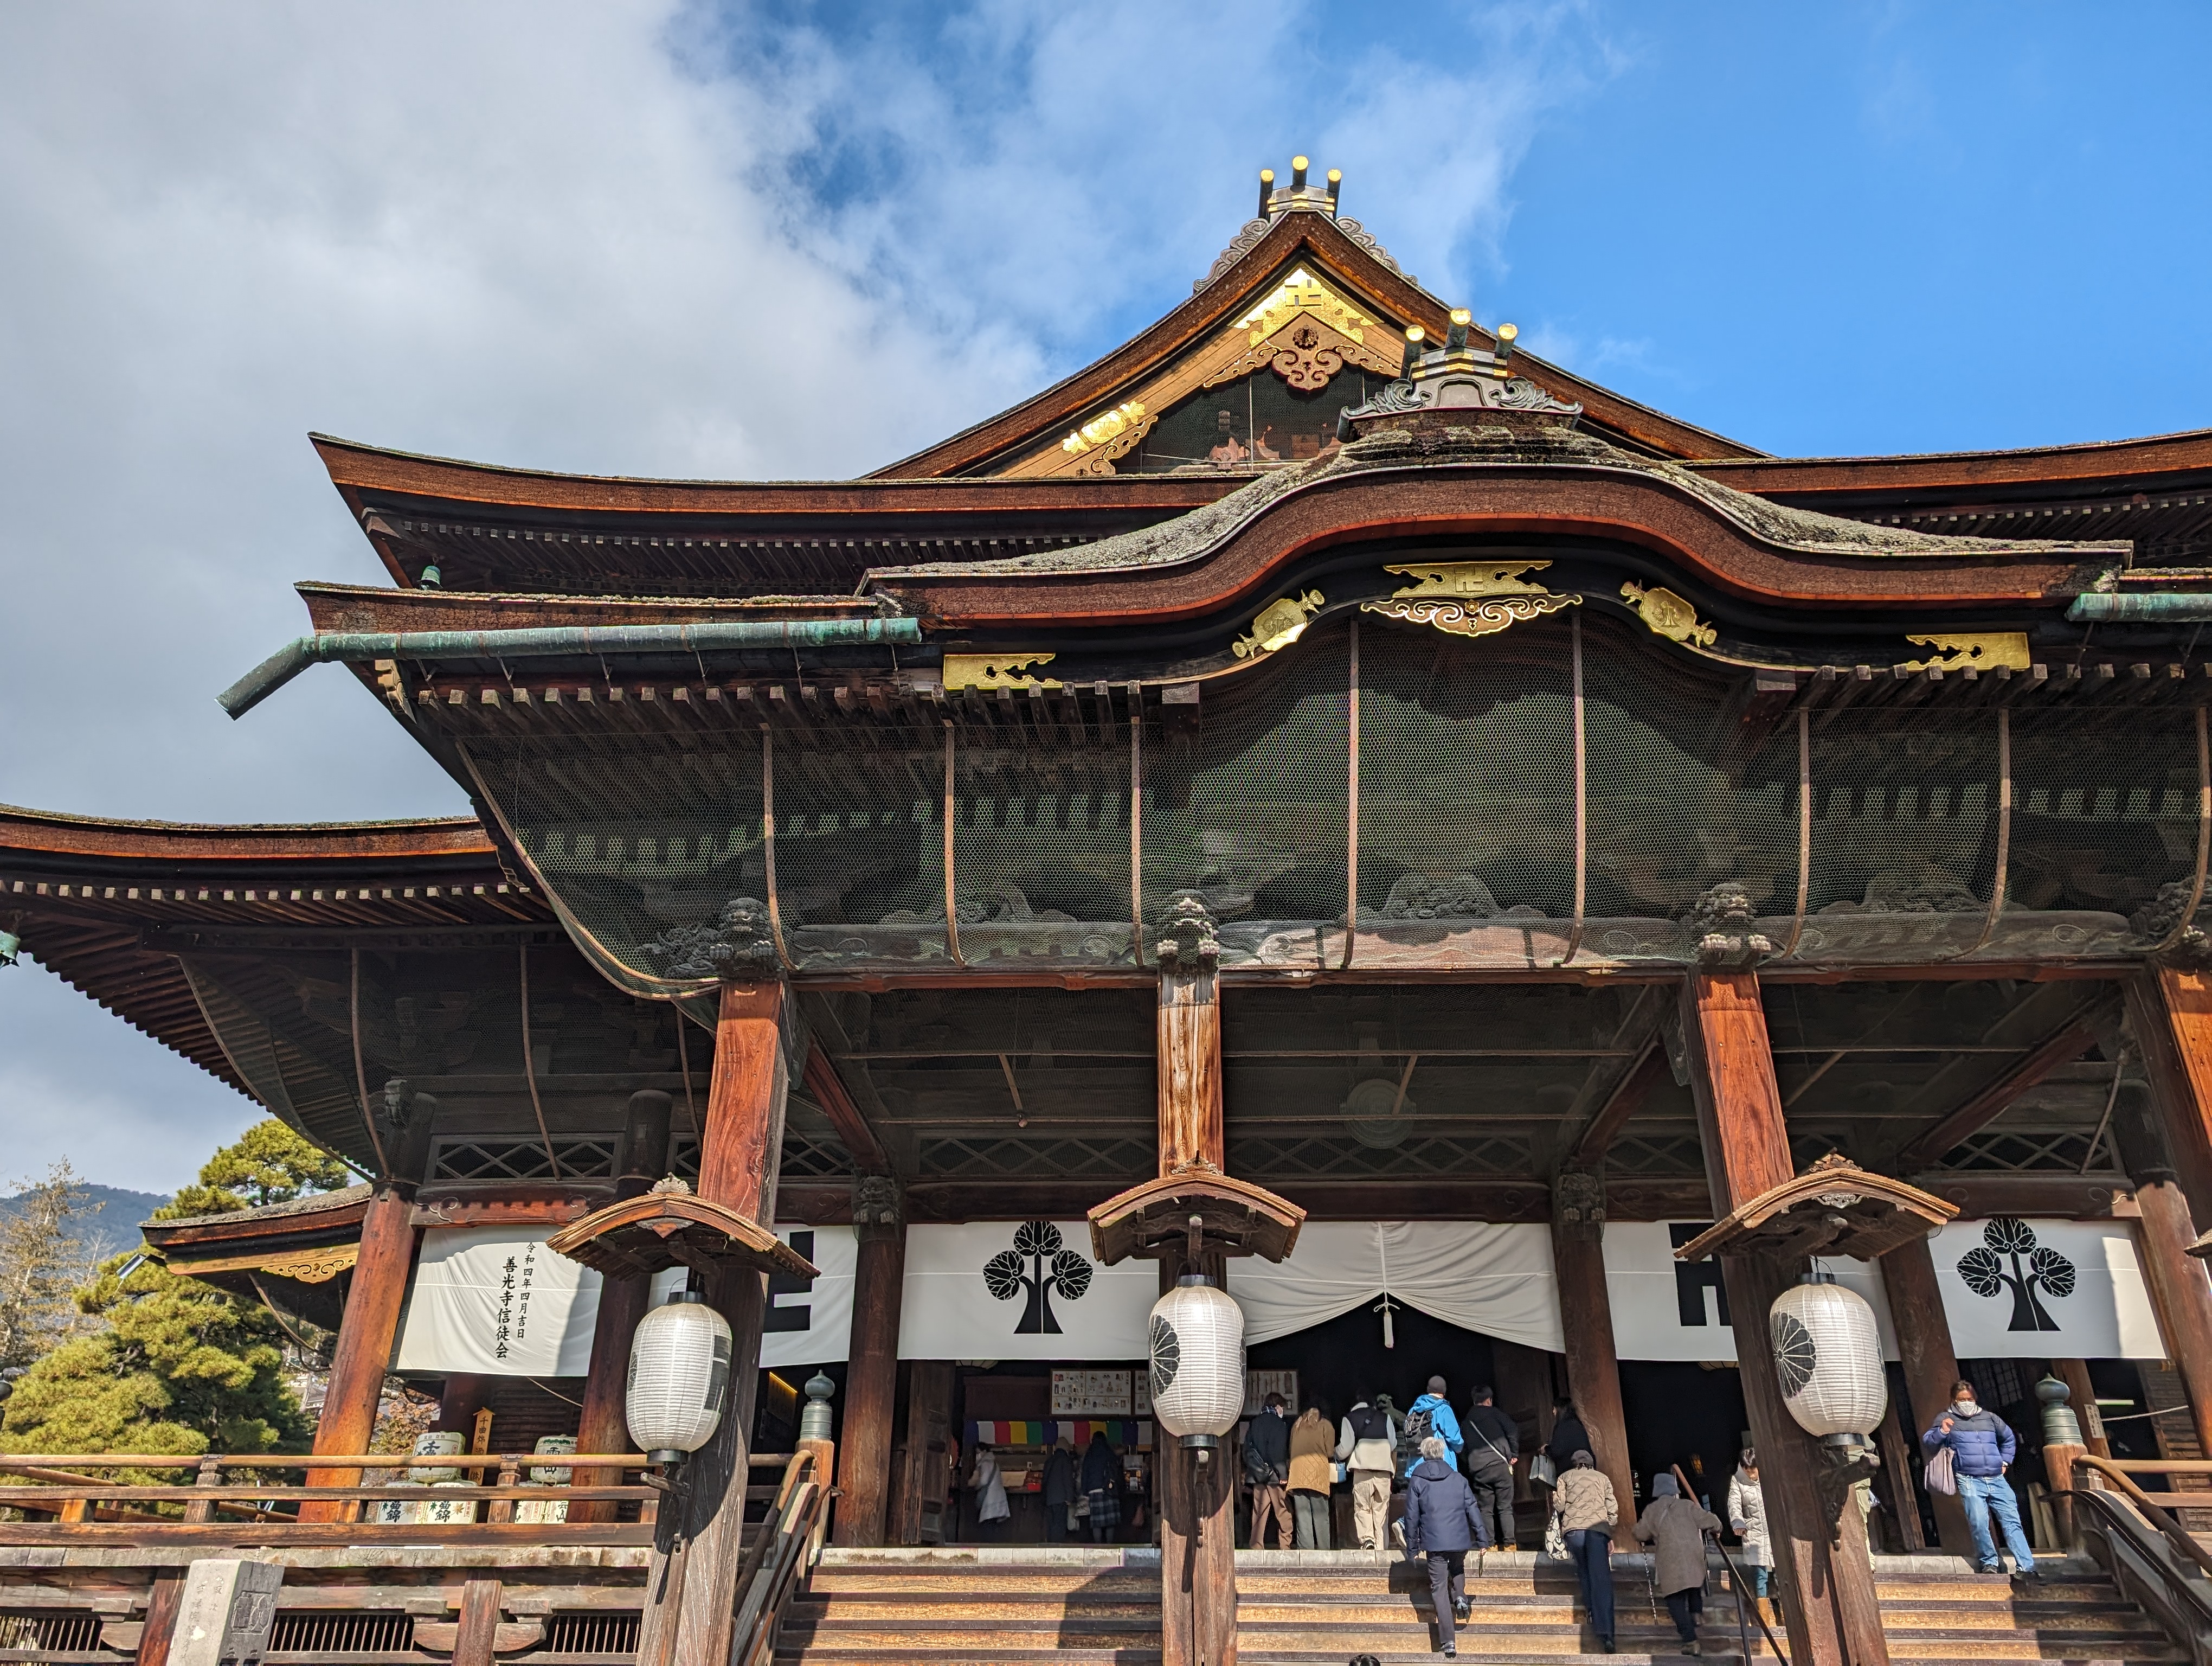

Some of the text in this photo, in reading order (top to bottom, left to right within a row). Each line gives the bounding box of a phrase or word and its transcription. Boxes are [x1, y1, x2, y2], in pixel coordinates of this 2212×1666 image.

[494, 1256, 518, 1359] 善光寺信徒会
[517, 1242, 536, 1339] 令和四年四月吉日
